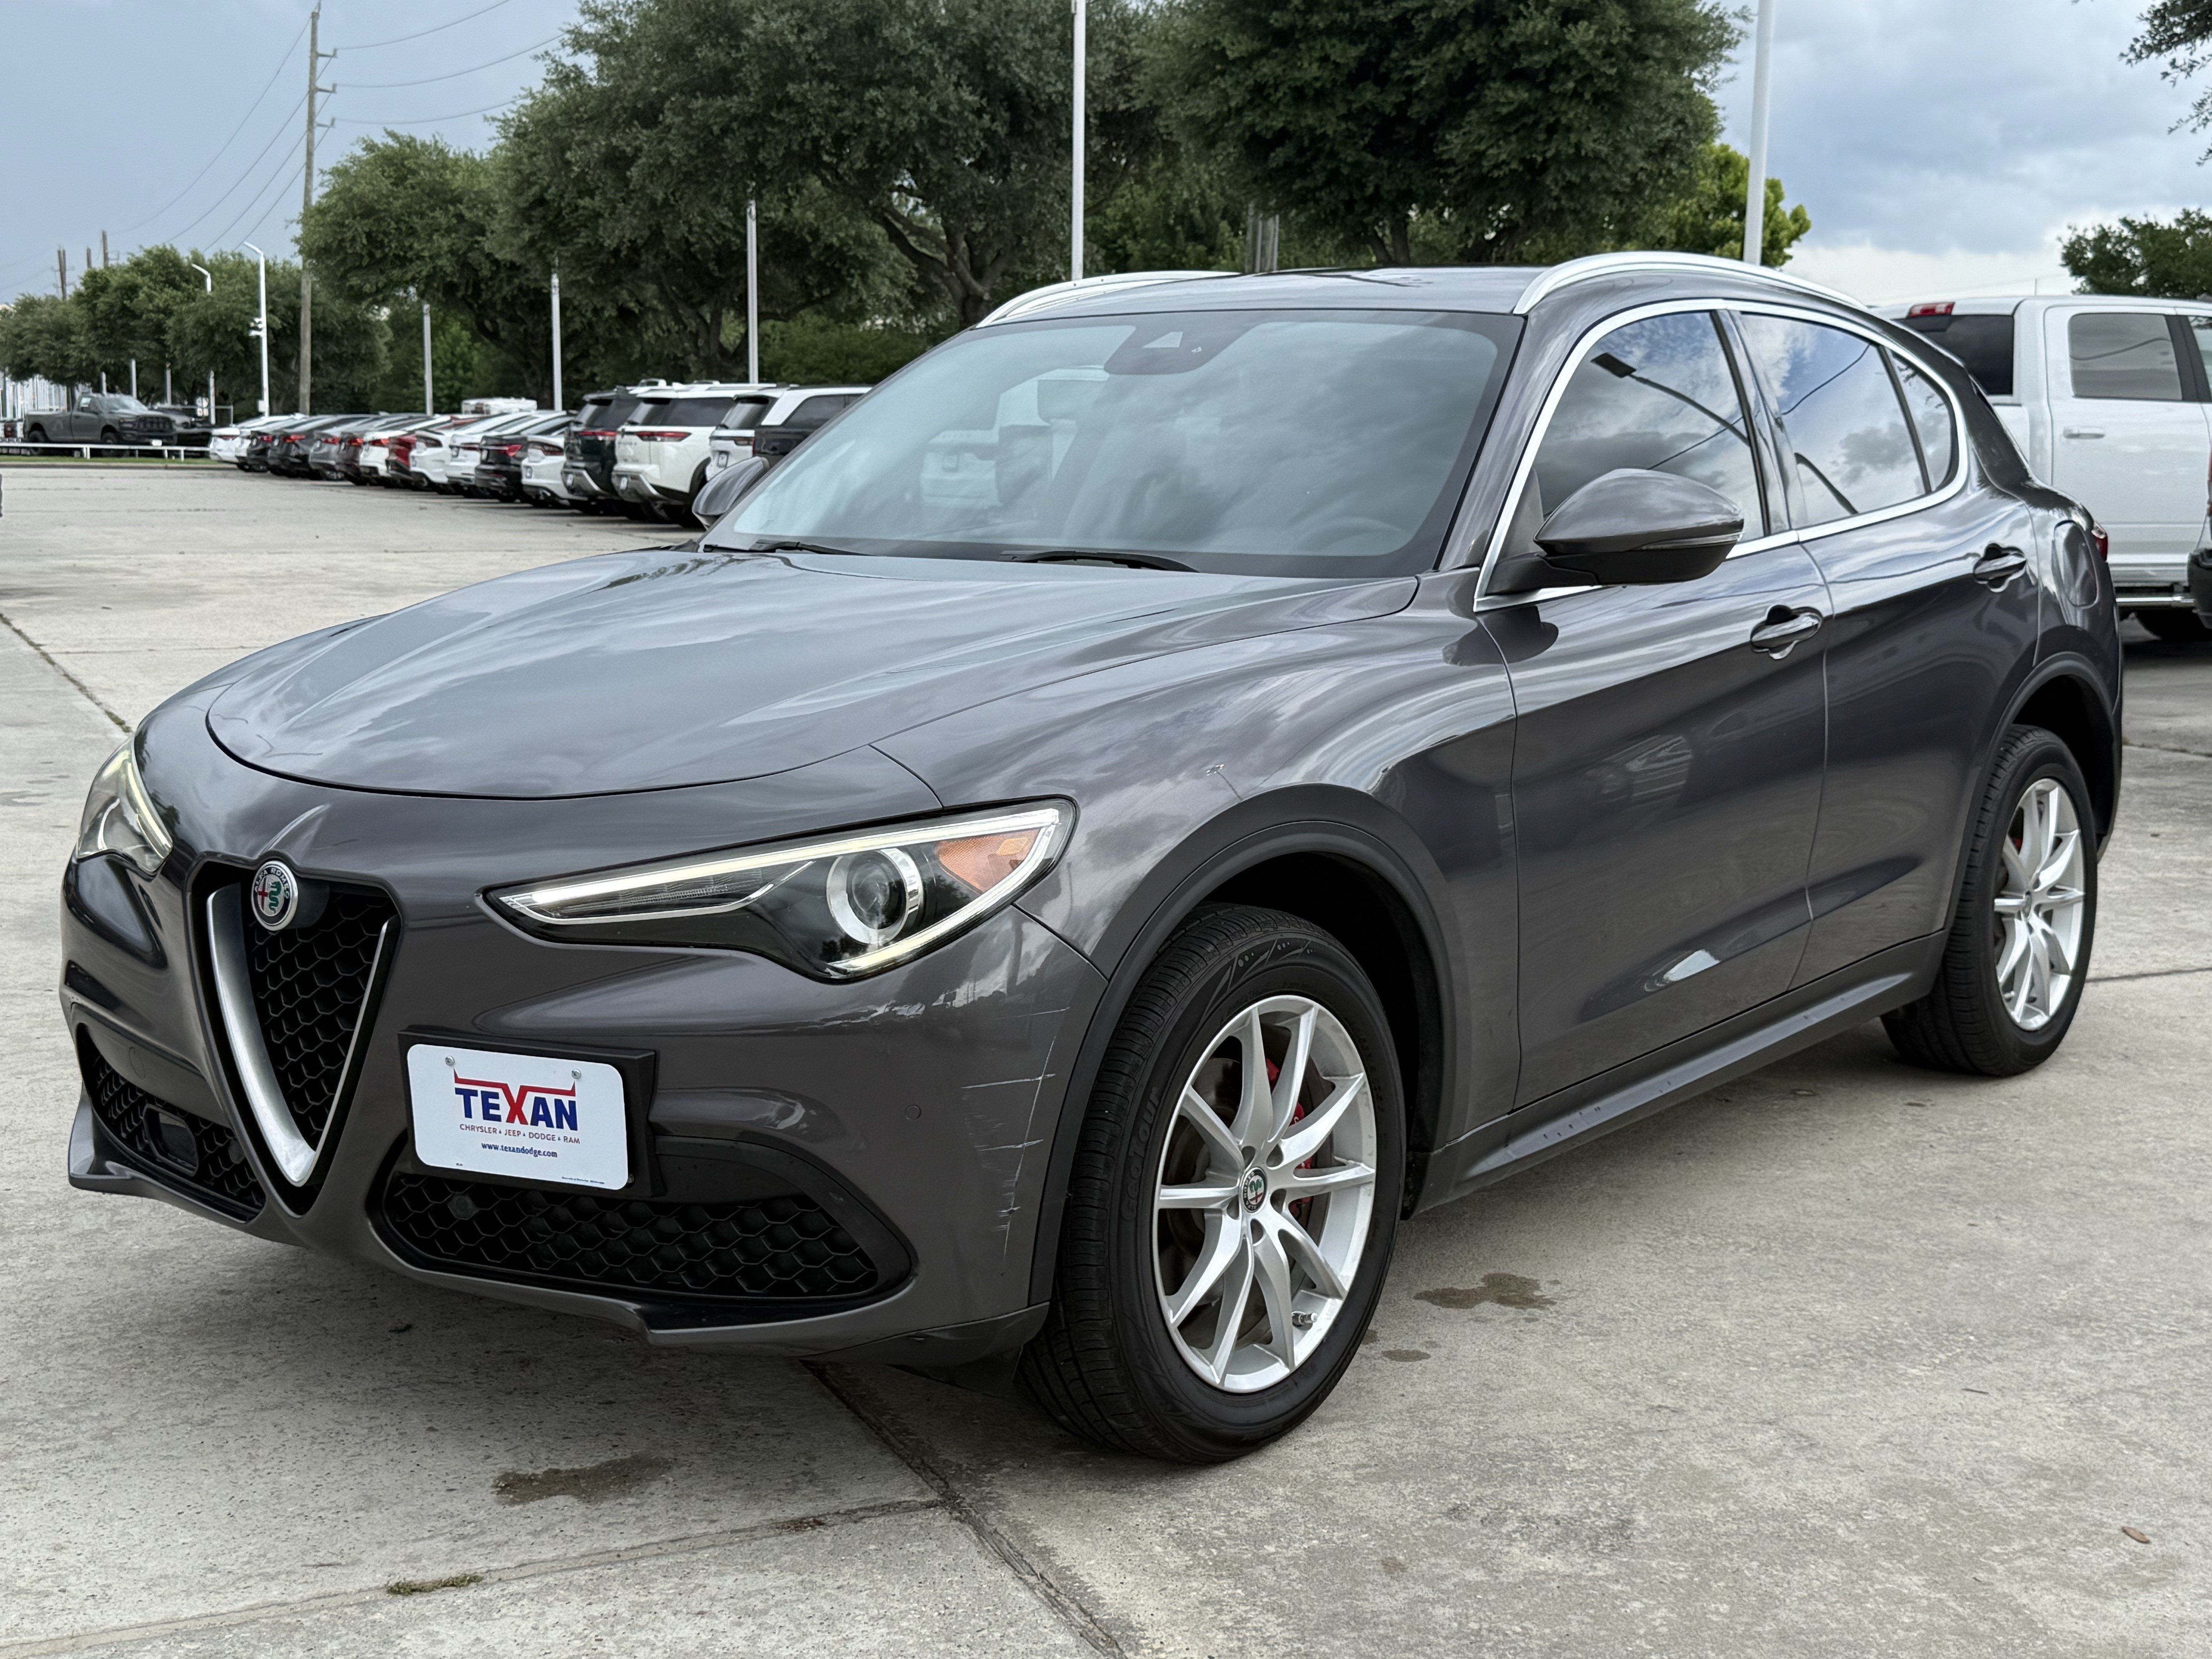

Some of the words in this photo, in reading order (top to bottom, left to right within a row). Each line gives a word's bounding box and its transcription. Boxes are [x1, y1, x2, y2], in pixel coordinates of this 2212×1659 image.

[255, 870, 268, 892] ALFA
[271, 868, 289, 898] ROMEO
[454, 1083, 578, 1131] TEXAN
[459, 1123, 497, 1134] CHRYSLER
[504, 1129, 521, 1137] JEEP
[529, 1132, 556, 1141] DODGE
[563, 1136, 580, 1144] RAM
[481, 1142, 558, 1158] www.texandodge.com
